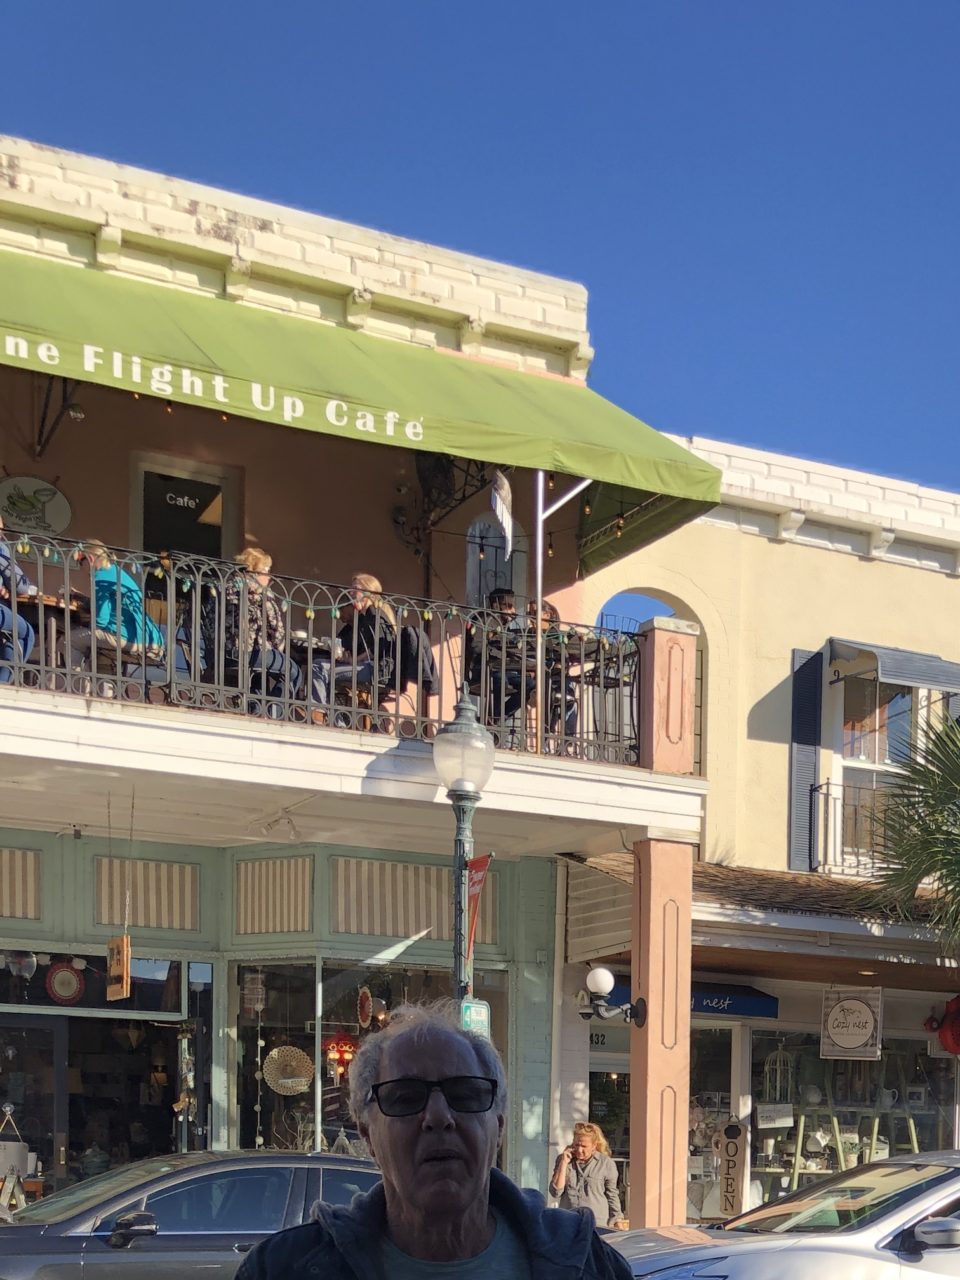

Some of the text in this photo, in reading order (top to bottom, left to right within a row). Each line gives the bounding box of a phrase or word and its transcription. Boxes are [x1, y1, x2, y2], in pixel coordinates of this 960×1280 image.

[83, 344, 229, 402] Flight
[251, 382, 304, 421] Up
[325, 400, 424, 441] Café
[703, 997, 733, 1010] nest
[832, 1017, 870, 1032] Cozy nest
[590, 1033, 606, 1046] 432
[723, 1141, 739, 1212] OPEN
